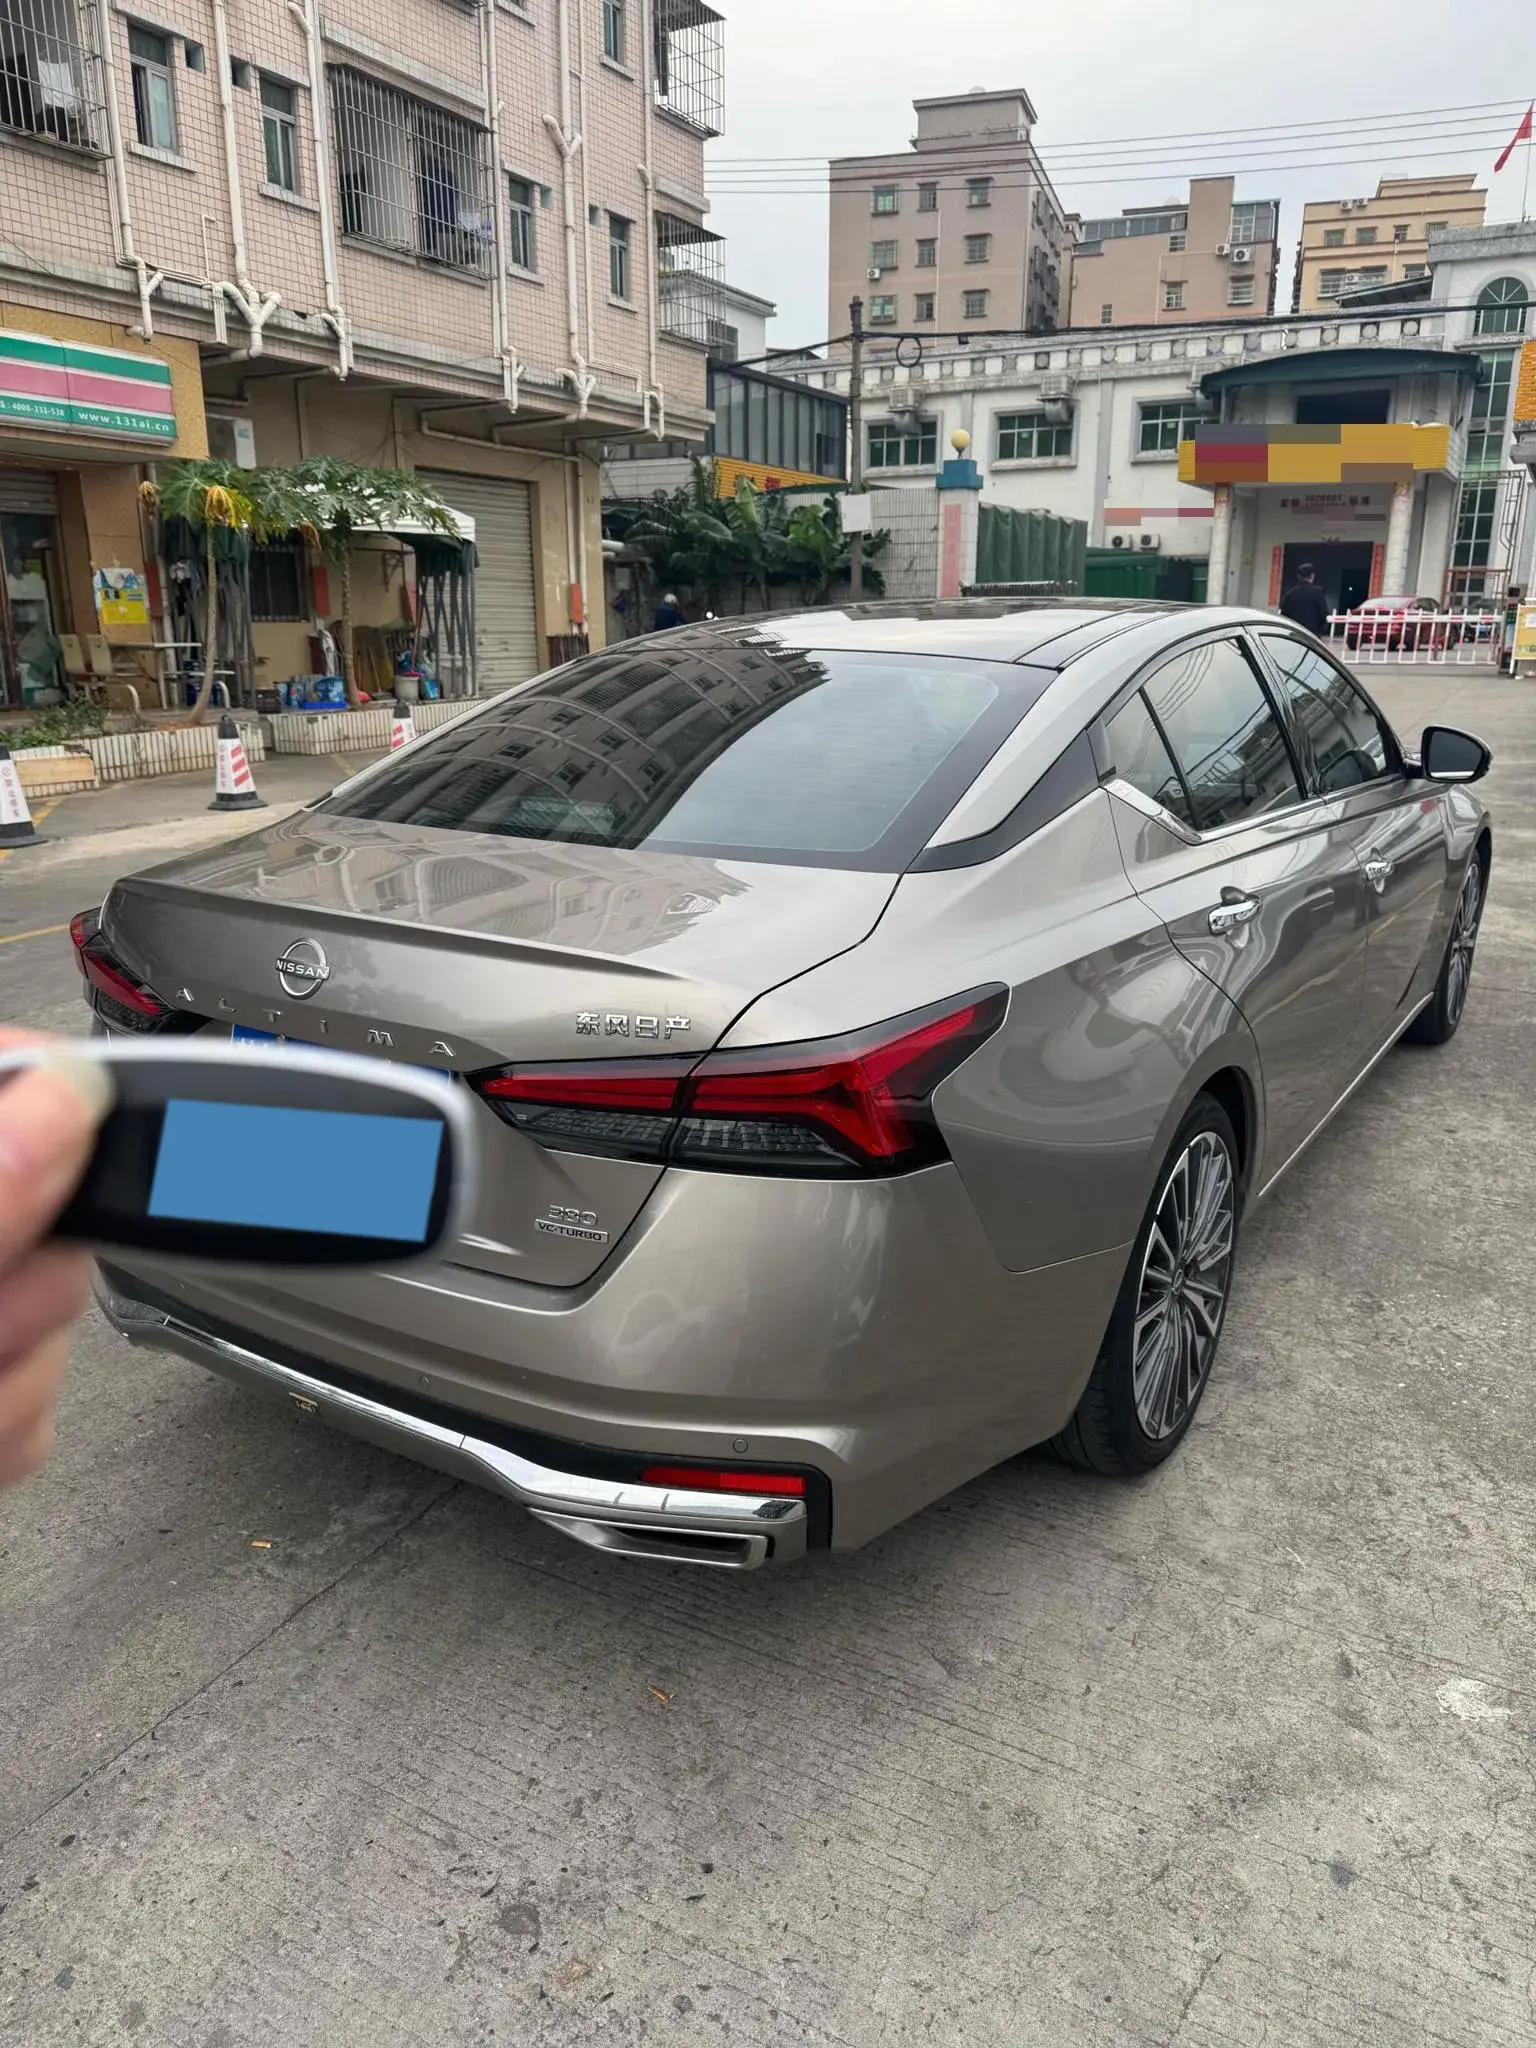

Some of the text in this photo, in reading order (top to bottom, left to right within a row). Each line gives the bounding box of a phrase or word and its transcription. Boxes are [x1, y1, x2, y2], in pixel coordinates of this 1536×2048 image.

[78, 412, 170, 432] www.131ai.cn
[276, 959, 330, 979] NISSAN
[176, 987, 456, 1057] ALTIMA
[575, 1011, 691, 1040] 东风日产
[548, 1204, 598, 1226] 380
